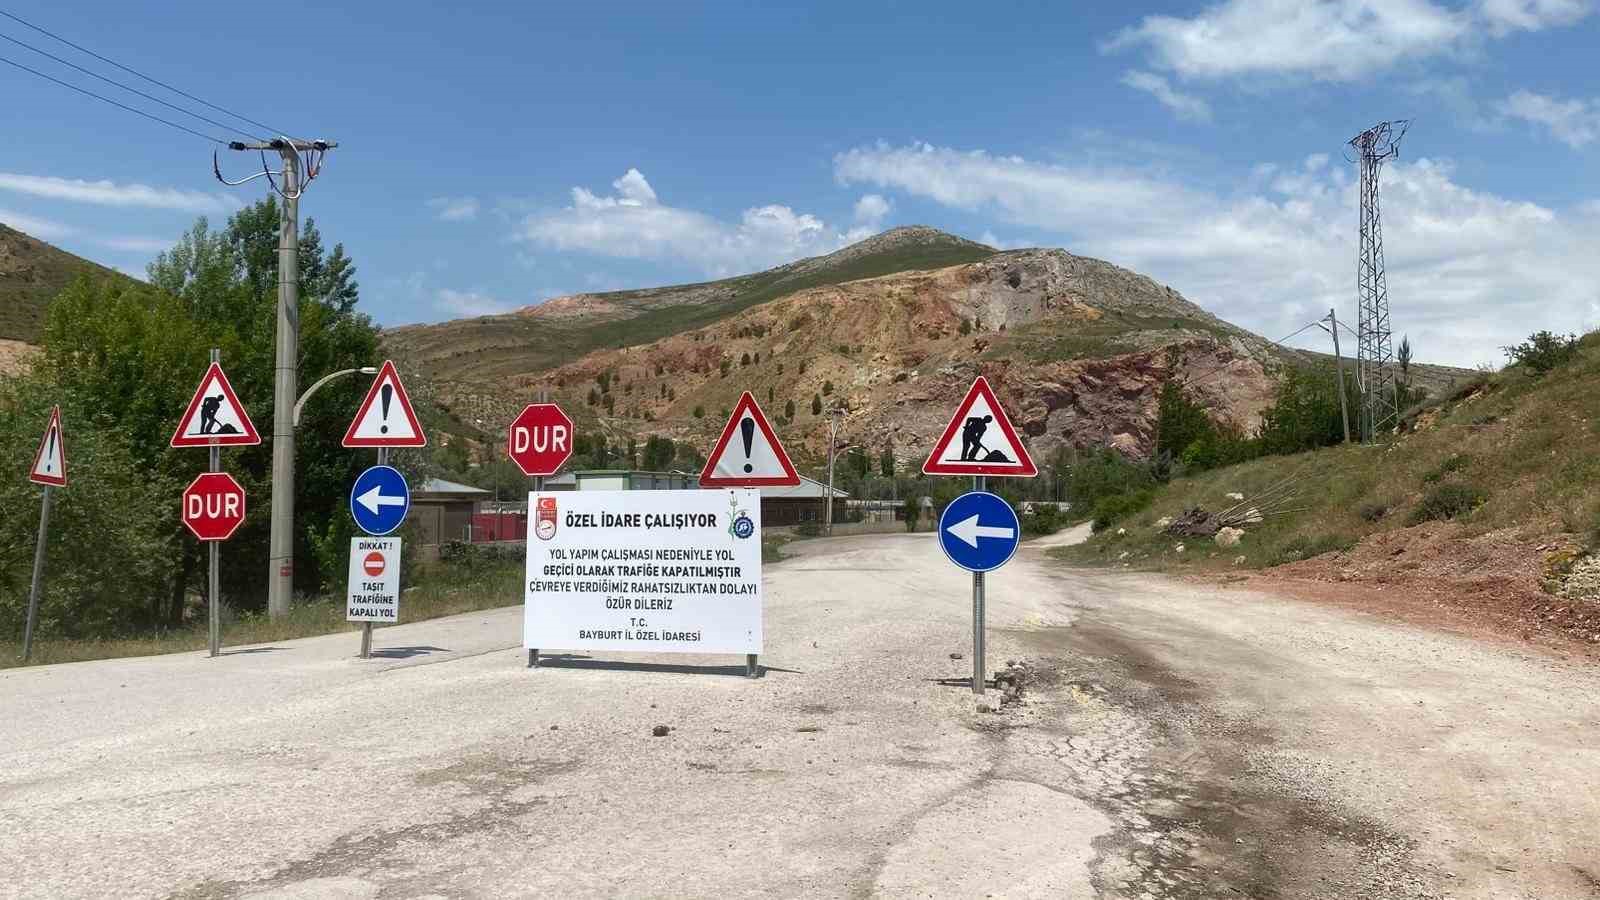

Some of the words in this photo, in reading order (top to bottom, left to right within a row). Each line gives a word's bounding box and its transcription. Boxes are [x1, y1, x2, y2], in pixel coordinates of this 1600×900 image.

[515, 425, 567, 453] DUR
[188, 492, 239, 519] DUR
[566, 511, 598, 527] ÖZEL
[601, 511, 641, 527] İDARE
[644, 513, 717, 529] ÇALIŞIYOR
[359, 541, 388, 550] DİKKAT
[549, 549, 567, 560] YOL
[569, 549, 599, 560] YAPIM
[601, 549, 653, 561] ÇALIŞMASI
[656, 547, 713, 560] NEDENİYLE
[715, 550, 735, 561] YOL
[543, 563, 574, 576] GEÇİCİ
[576, 565, 615, 576] OLARAK
[617, 563, 659, 577] TRAFİĞE
[661, 566, 741, 579] KAPATILMIŞTIR
[362, 582, 385, 591] TAŞIT
[529, 580, 571, 593] ÇEVREYE
[573, 579, 629, 593] VERDİĞİMİZ
[631, 582, 717, 594] RAHATSIZLIKTAN
[719, 583, 757, 595] DOLAYI
[352, 593, 393, 604] TRAFİĞİNE
[606, 596, 632, 609] ÖZÜR
[634, 597, 673, 610] DİLERİZ
[349, 607, 378, 617] KAPALI
[379, 608, 395, 617] YOL
[630, 617, 648, 627] T.C.
[579, 630, 623, 640] BAYBURT
[625, 629, 634, 640] İL
[636, 630, 660, 641] ÖZEL
[662, 630, 701, 642] İDARESİ
